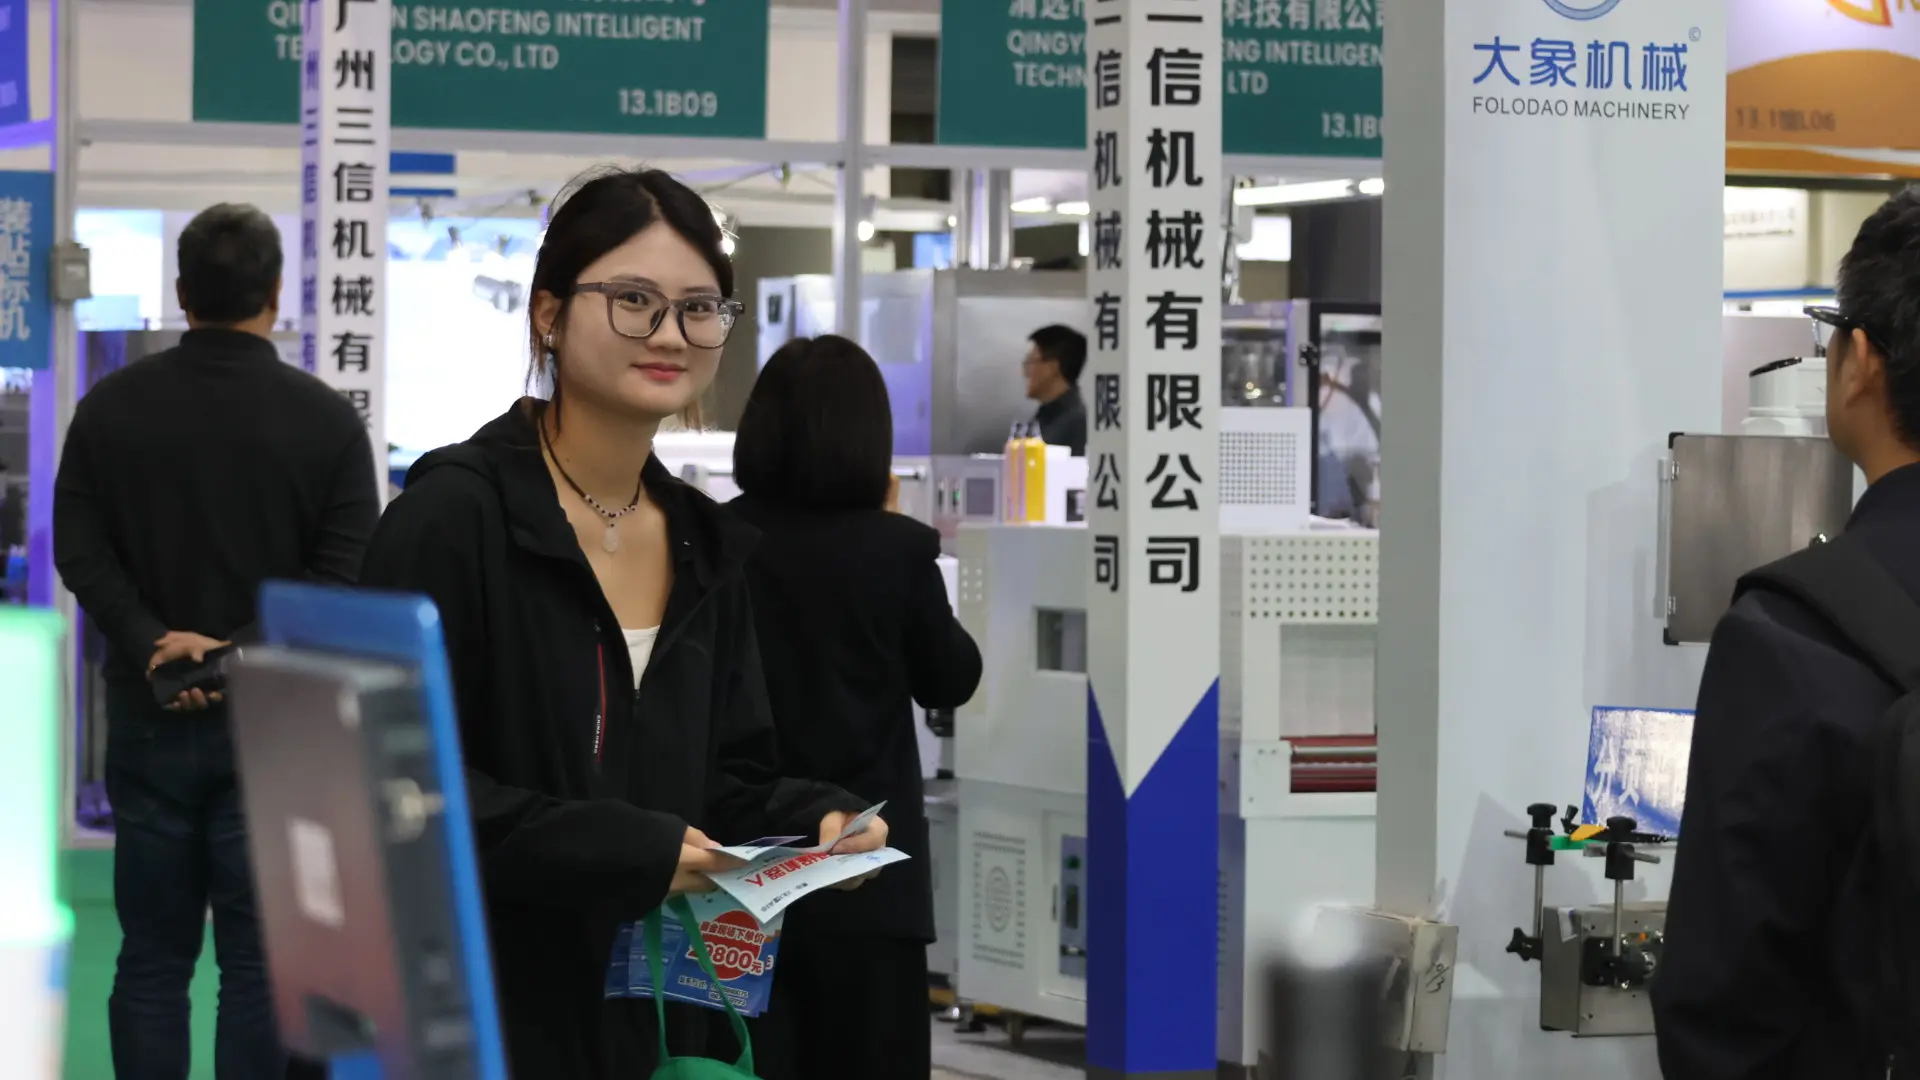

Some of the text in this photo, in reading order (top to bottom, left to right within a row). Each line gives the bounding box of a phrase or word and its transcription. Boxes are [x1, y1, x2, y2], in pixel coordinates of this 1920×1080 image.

[412, 6, 551, 36] SHAOFENG
[555, 13, 706, 41] INTELLIGENT
[454, 41, 509, 70] CO.,
[512, 44, 560, 70] LTD
[1007, 29, 1086, 57] QINGY
[1265, 40, 1384, 67] INTELLIGEN
[1013, 62, 1087, 88] TECHN
[1473, 37, 1688, 92] 大象机械
[1227, 70, 1268, 95] LTD
[617, 88, 719, 117] 13.1B09
[1473, 97, 1690, 121] FOLODAO MACHINERY
